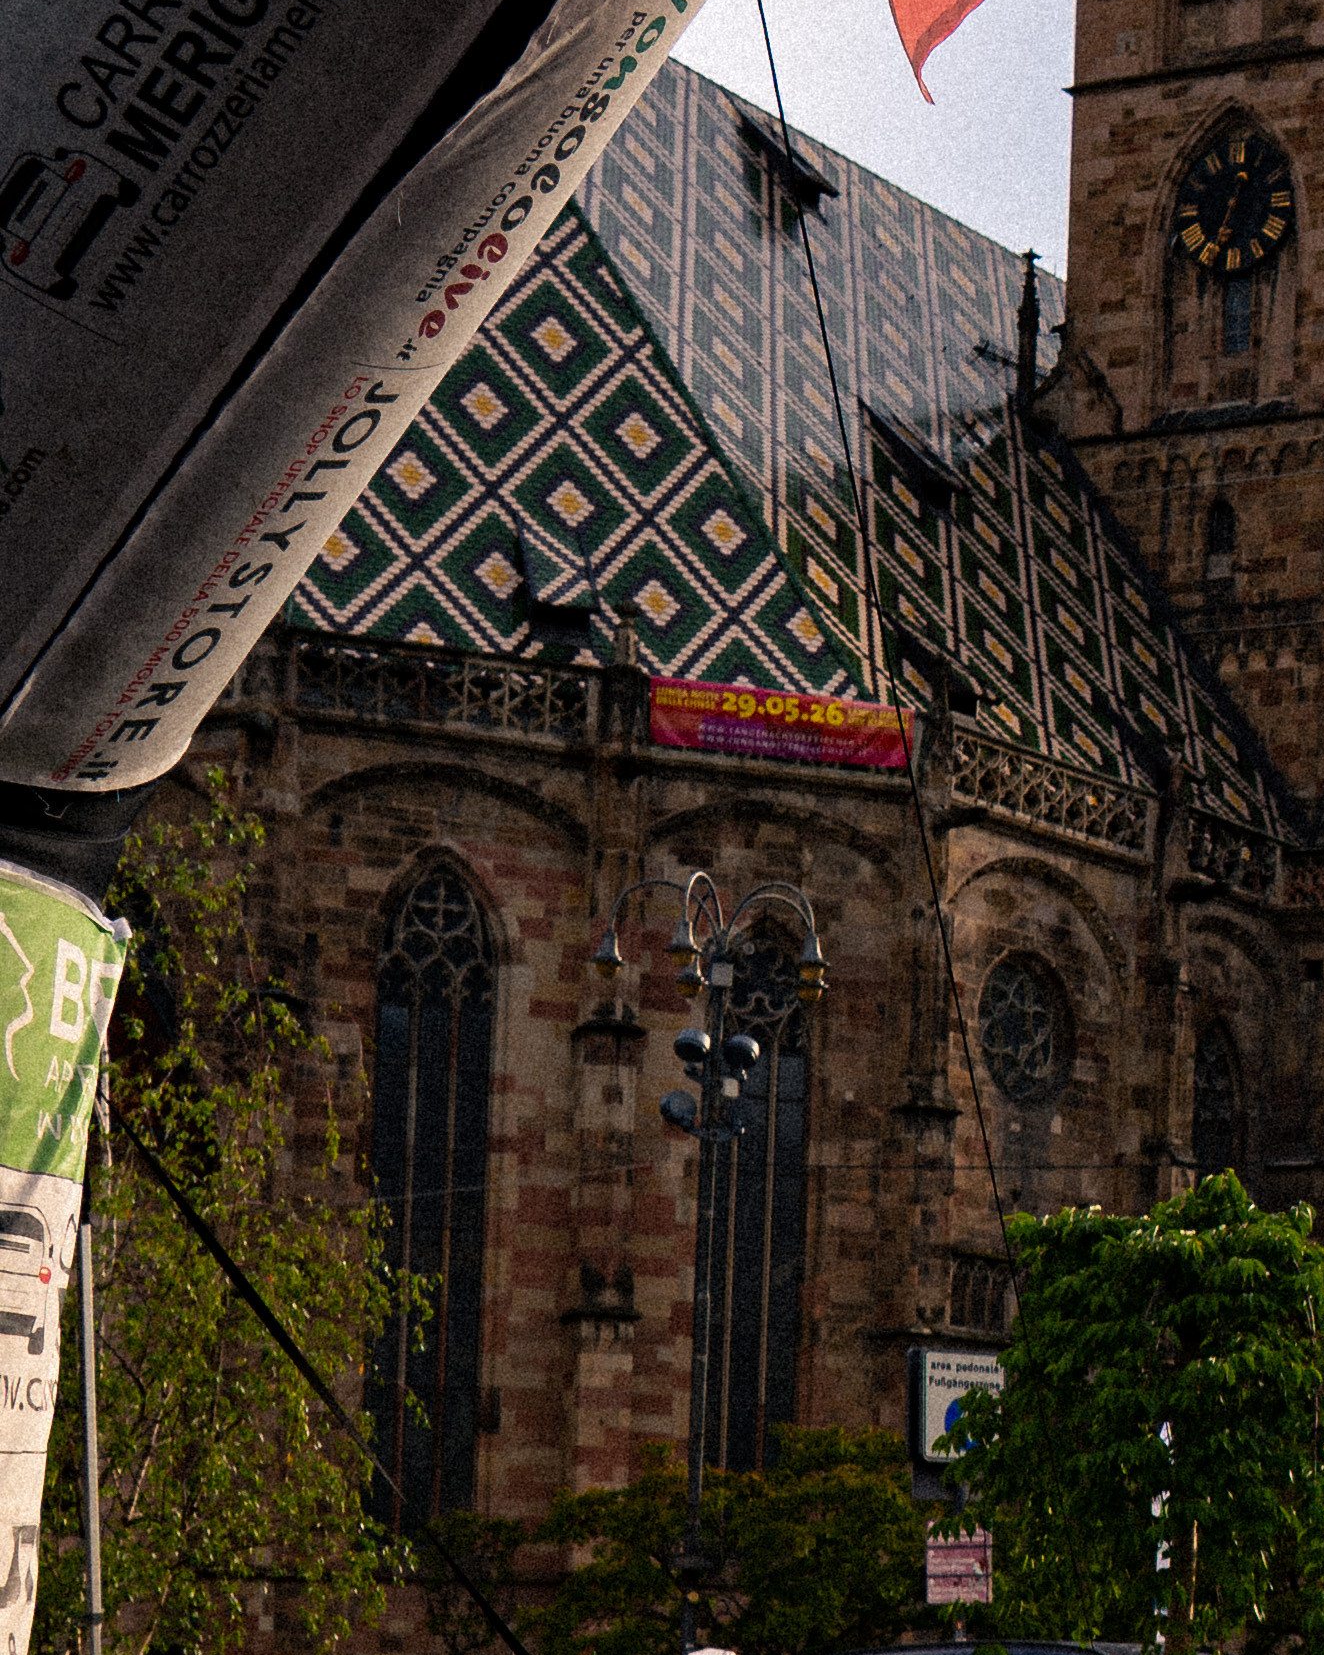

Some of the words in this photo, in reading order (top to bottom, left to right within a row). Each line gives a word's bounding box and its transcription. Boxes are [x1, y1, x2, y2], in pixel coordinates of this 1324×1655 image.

[614, 10, 647, 50] per
[574, 55, 616, 105] una
[516, 101, 570, 175] buona
[415, 179, 518, 305] compagnia
[346, 375, 369, 399] LO
[305, 401, 347, 455] SHOP
[239, 457, 306, 549] UFFICIALE
[193, 549, 239, 605] DELLA
[167, 605, 197, 644] 500
[116, 644, 171, 704] MIGLIA
[722, 691, 844, 726] 29.05.26
[956, 1361, 999, 1373] pedonale
